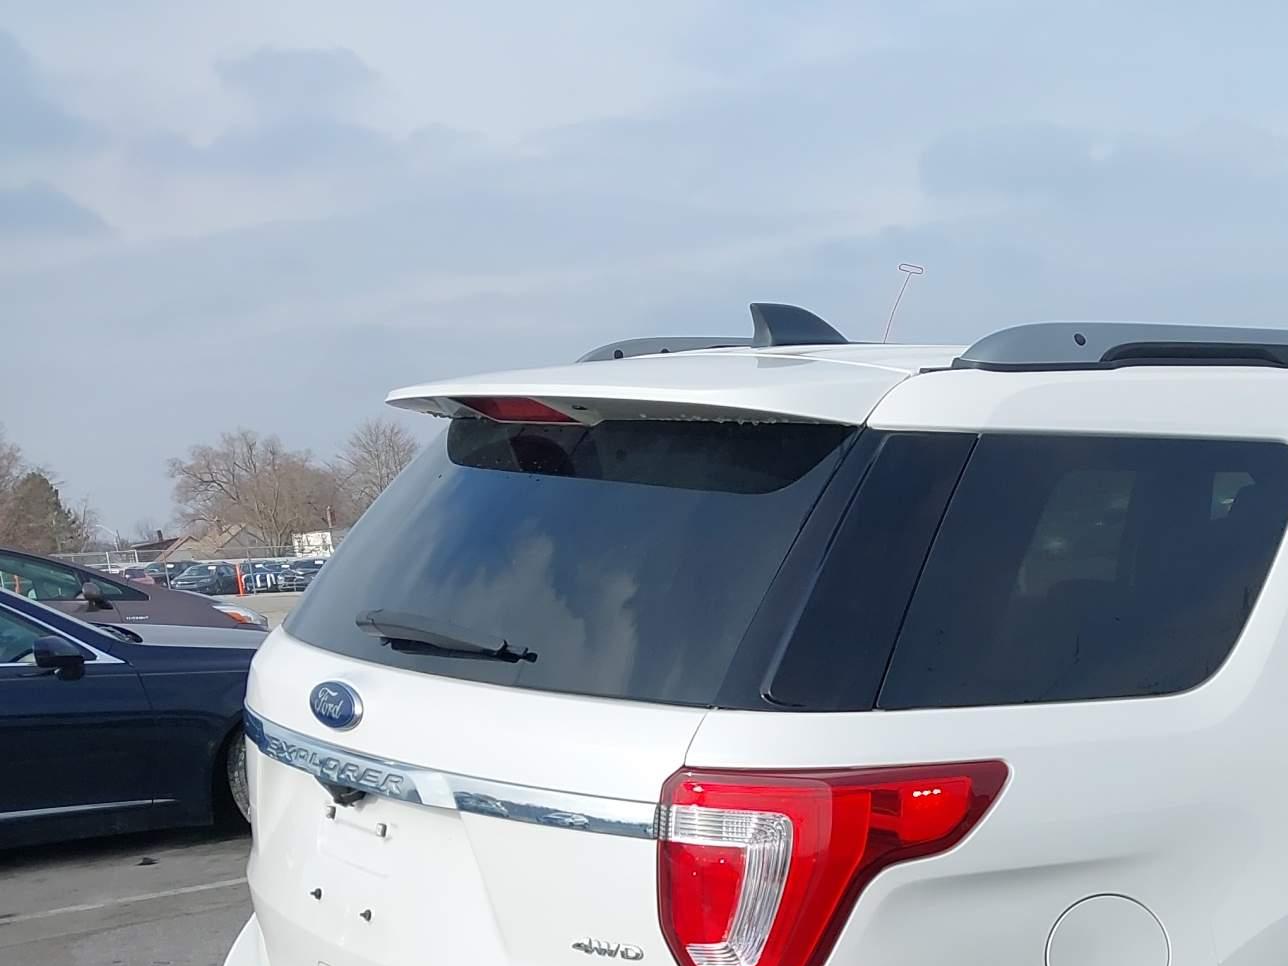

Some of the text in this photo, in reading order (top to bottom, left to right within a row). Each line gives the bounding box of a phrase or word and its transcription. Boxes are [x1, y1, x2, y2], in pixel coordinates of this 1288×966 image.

[315, 687, 344, 719] Ford
[267, 735, 404, 795] EXPLORER
[572, 938, 644, 960] 4WD
